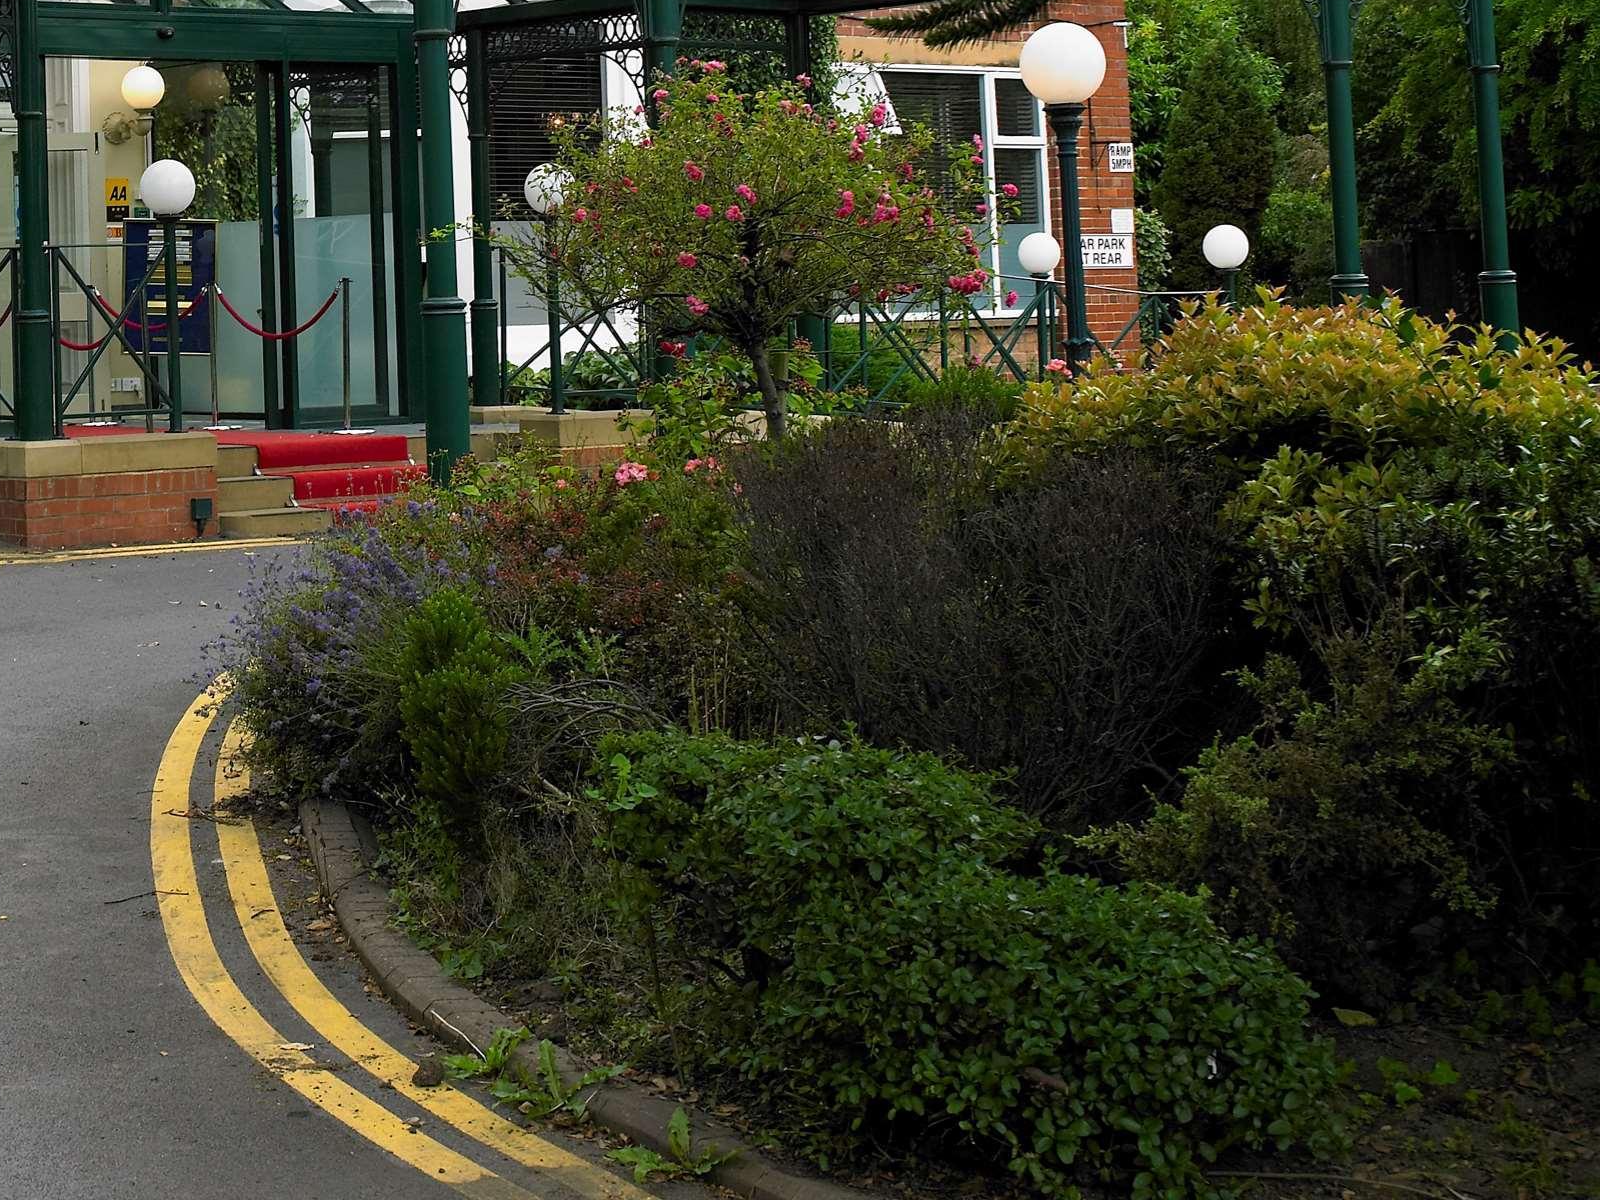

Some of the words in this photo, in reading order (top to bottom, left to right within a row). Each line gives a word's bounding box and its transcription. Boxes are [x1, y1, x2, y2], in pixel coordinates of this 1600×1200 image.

[1110, 145, 1131, 157] RAMP
[1111, 158, 1132, 169] 5MPH
[110, 186, 127, 201] AA
[1080, 238, 1095, 250] AR
[1097, 238, 1126, 250] PARK
[1092, 252, 1122, 265] REAR
